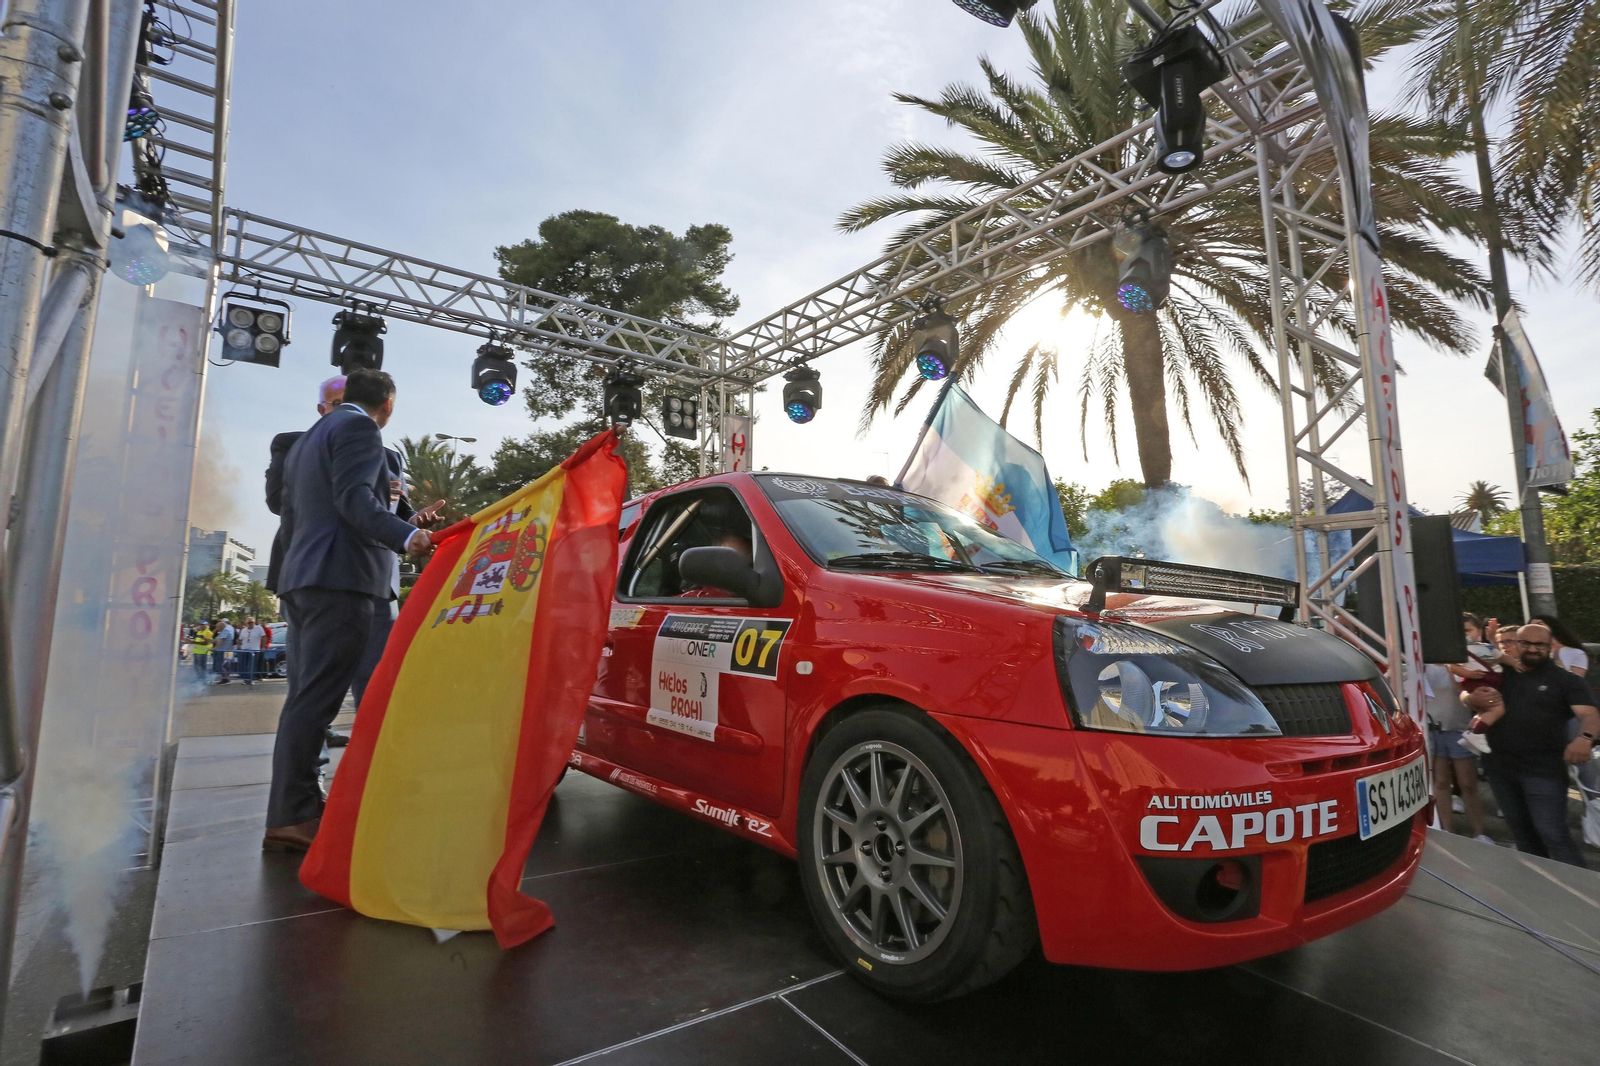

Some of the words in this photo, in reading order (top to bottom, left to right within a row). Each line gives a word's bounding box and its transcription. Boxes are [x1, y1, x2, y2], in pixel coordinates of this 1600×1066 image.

[735, 627, 783, 669] 07
[671, 695, 703, 722] PROHI
[1147, 790, 1273, 810] AUTOMÓVILES
[1368, 780, 1389, 825] SS
[1139, 799, 1339, 853] CAPOTE
